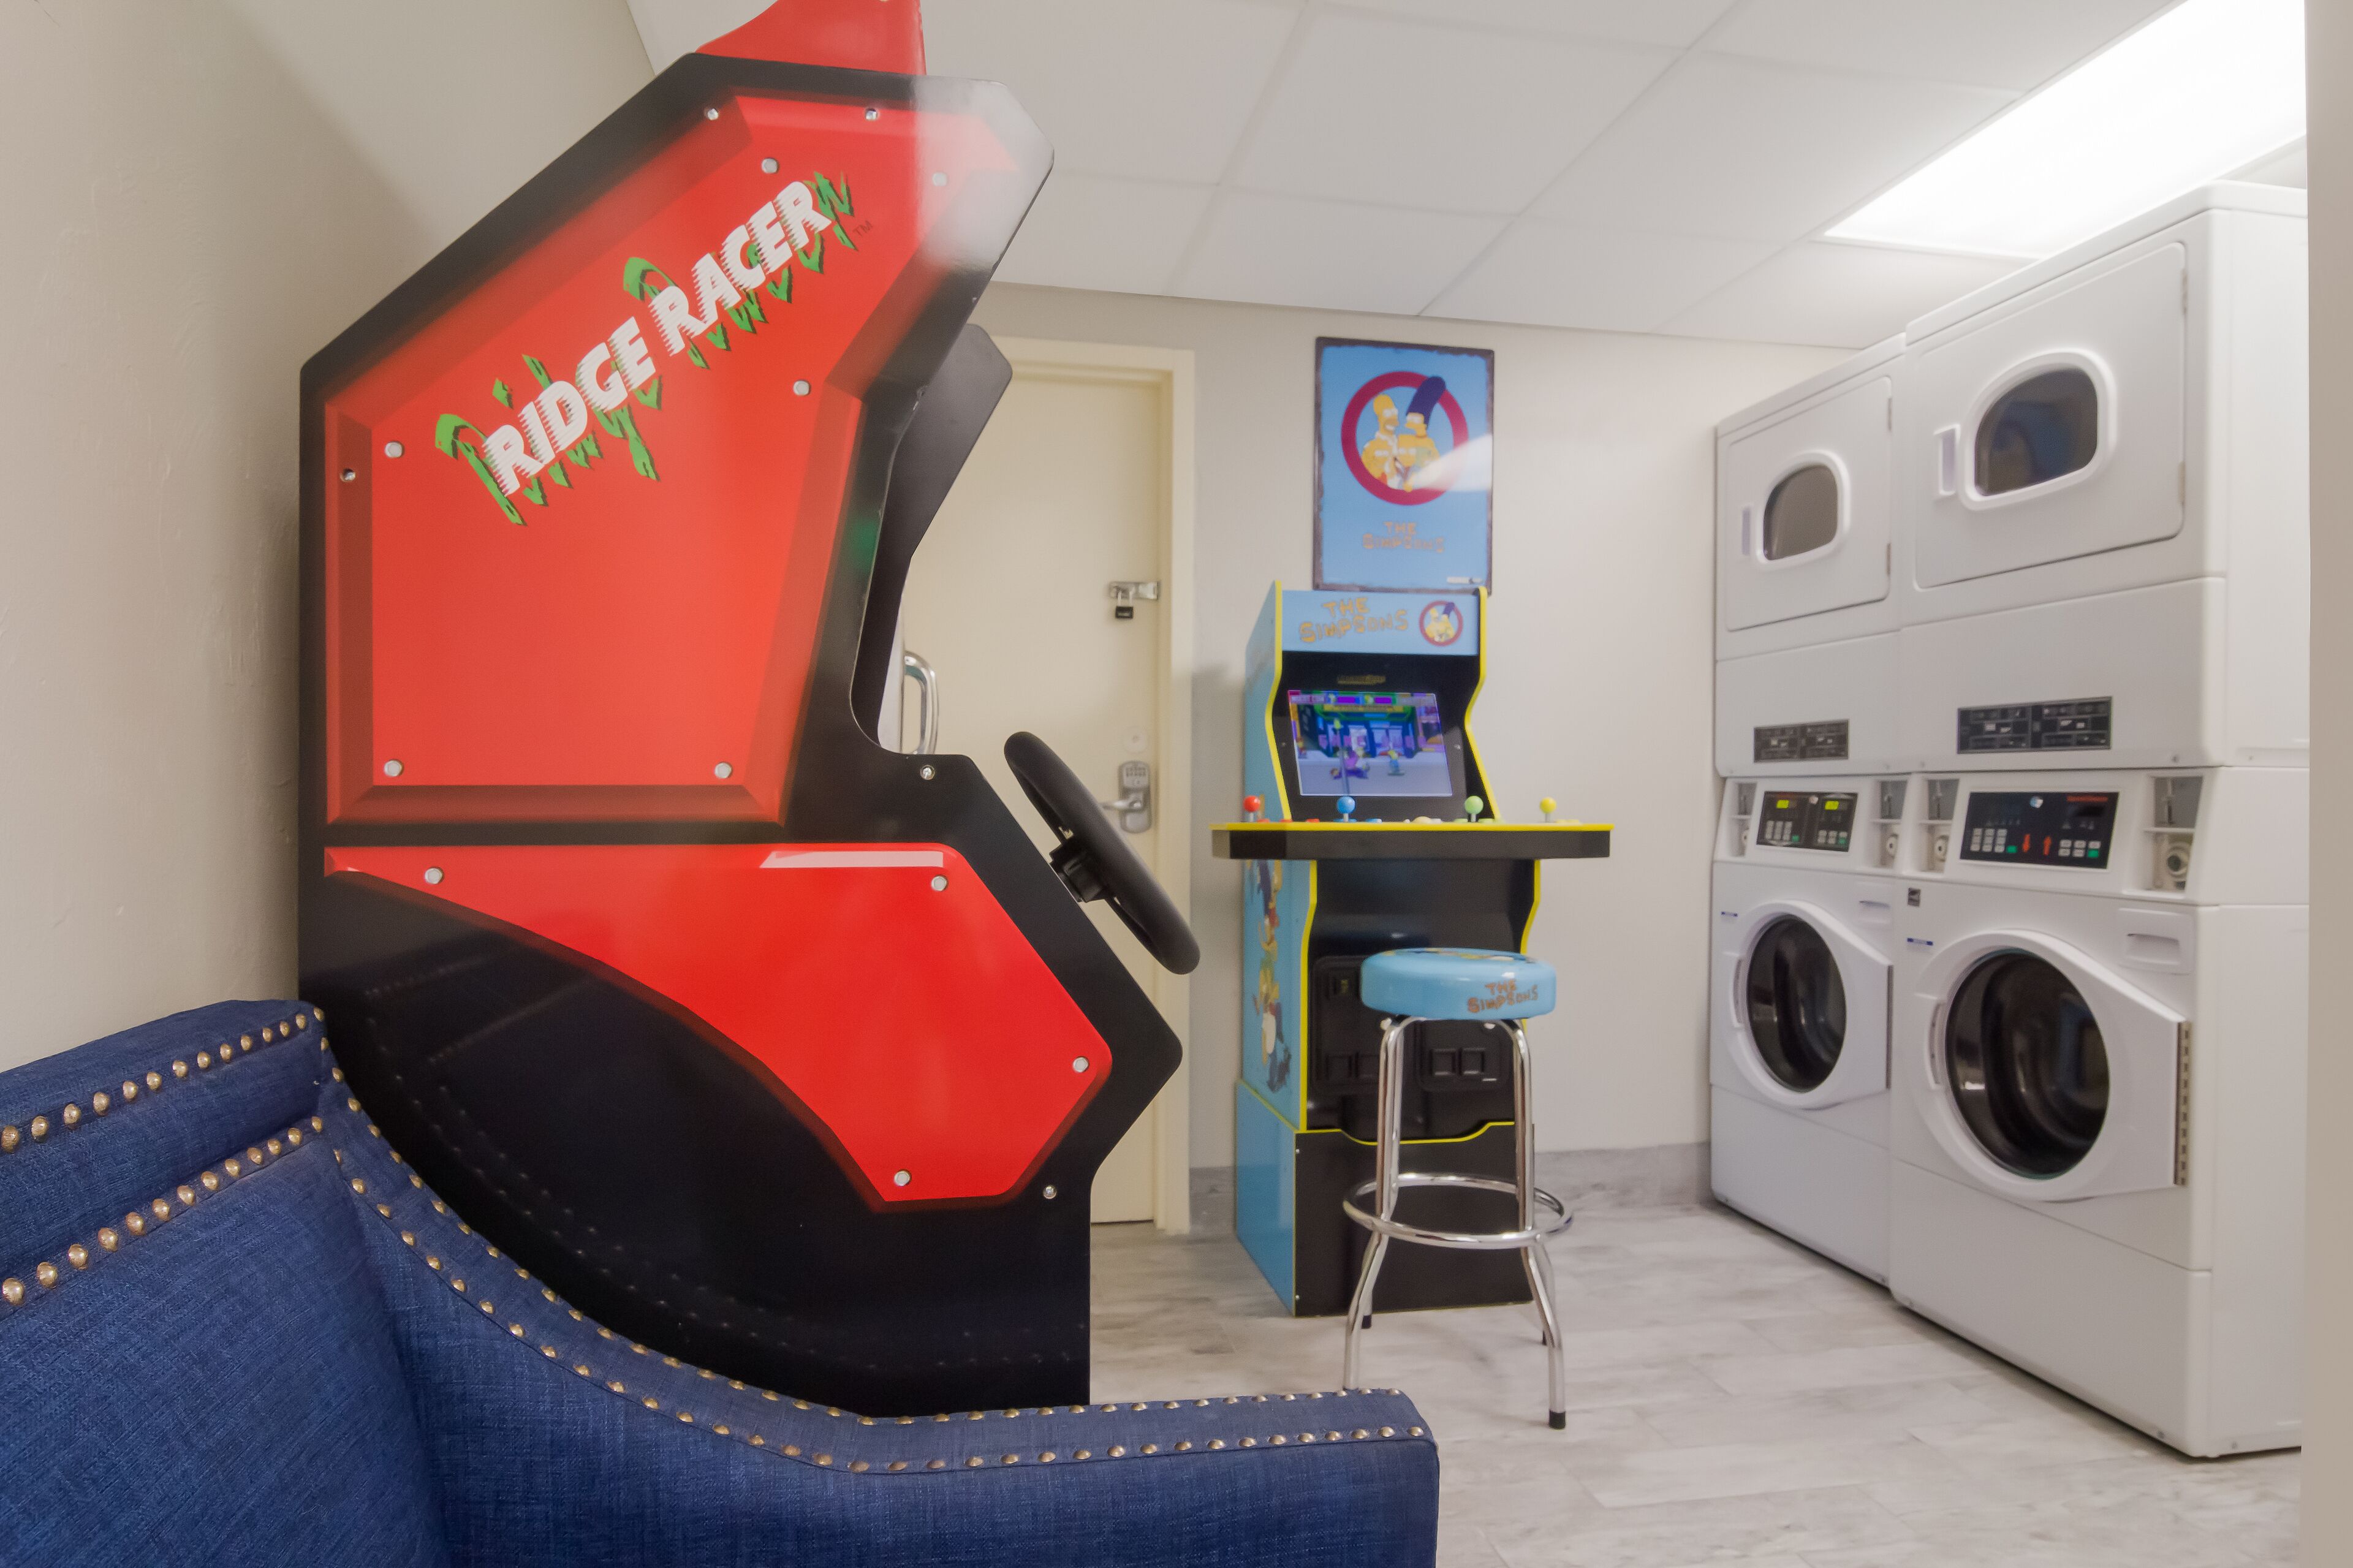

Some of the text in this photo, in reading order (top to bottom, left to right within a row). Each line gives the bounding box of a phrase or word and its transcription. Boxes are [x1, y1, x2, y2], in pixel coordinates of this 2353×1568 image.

[482, 316, 656, 497] RIDGE
[648, 181, 832, 357] RACER
[1382, 521, 1417, 535] THE
[1322, 597, 1370, 618] THE
[1299, 609, 1408, 643] SIMPSONS
[1467, 984, 1539, 1013] SIMPSONS
[1485, 979, 1517, 995] THE
